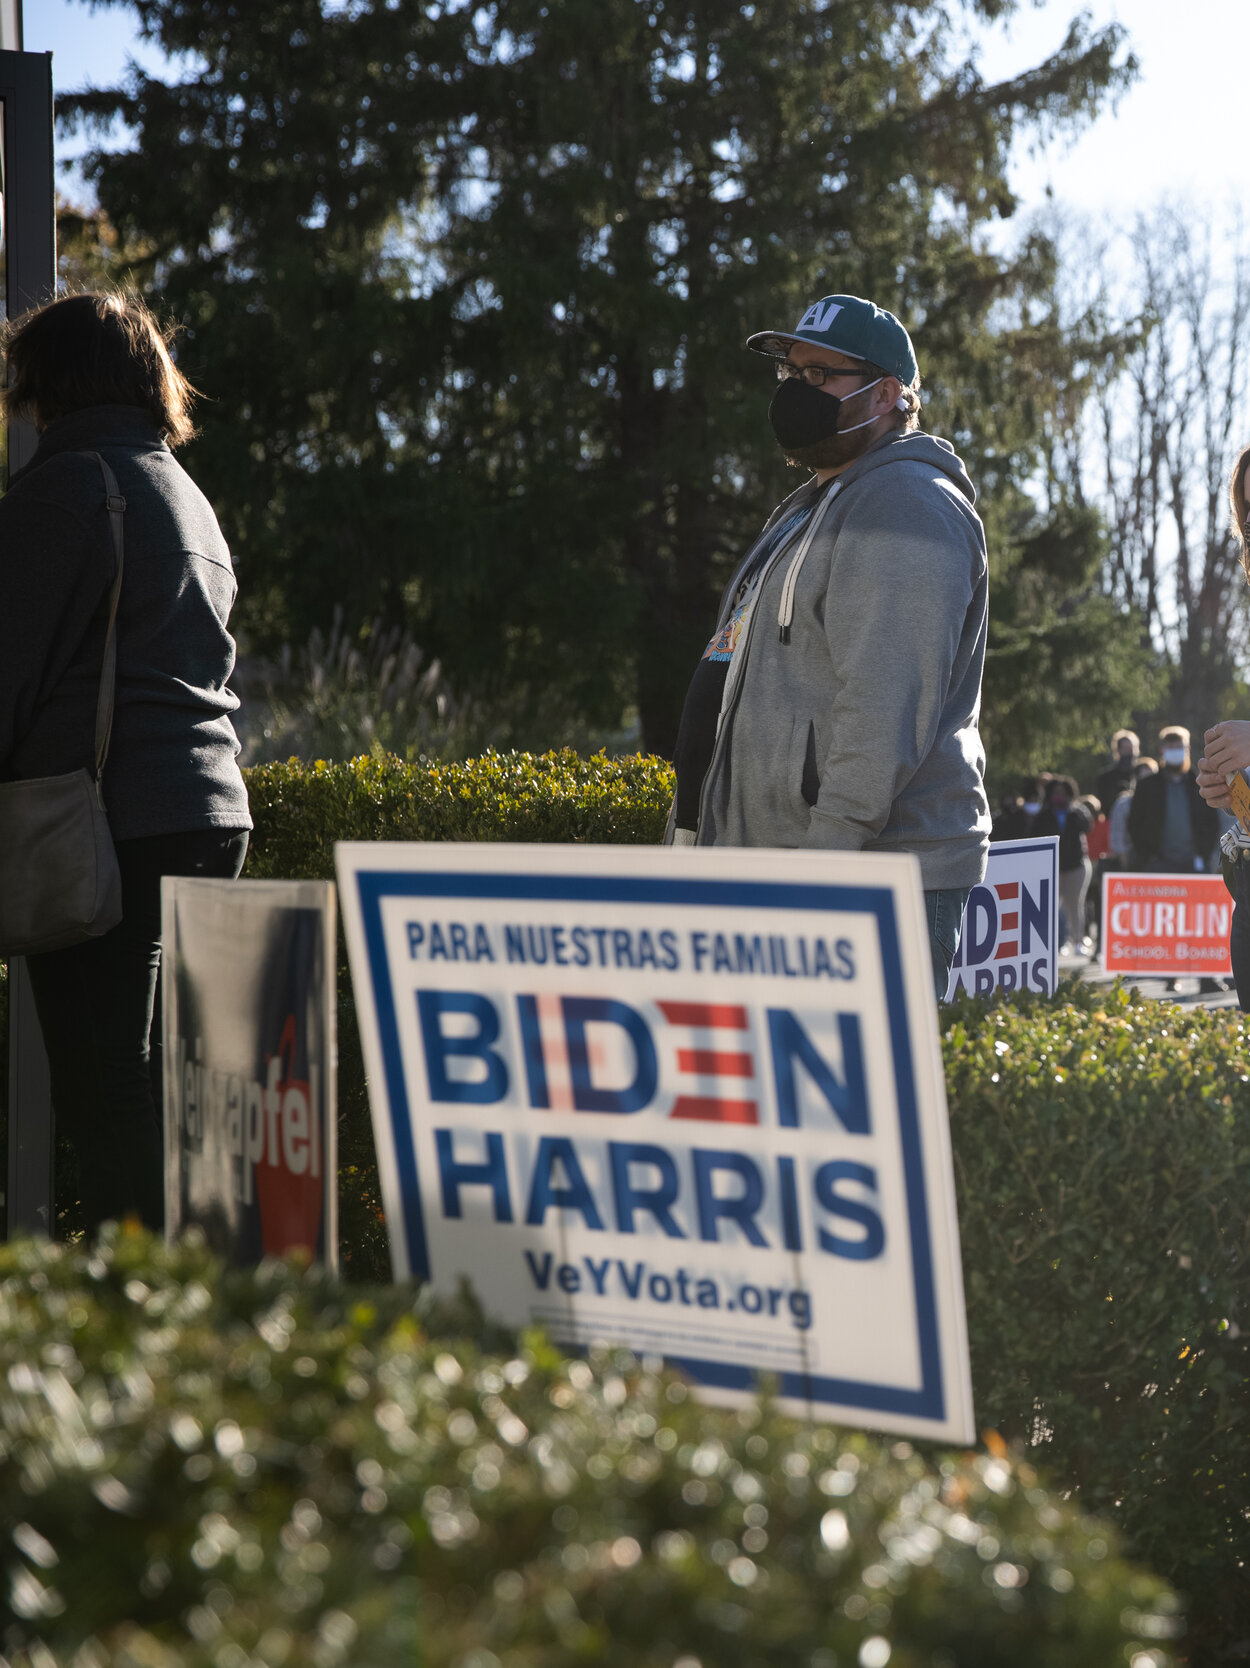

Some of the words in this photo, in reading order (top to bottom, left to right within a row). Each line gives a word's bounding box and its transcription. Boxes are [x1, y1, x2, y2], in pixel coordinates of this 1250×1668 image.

[405, 919, 496, 964] PARA
[503, 923, 680, 972] NUESTRAS
[692, 932, 857, 981] FAMILIAS
[1110, 901, 1229, 938] CURLIN
[415, 988, 873, 1137] BIDEN
[434, 1127, 888, 1262] HARRIS
[524, 1248, 814, 1331] VeYVota.org
